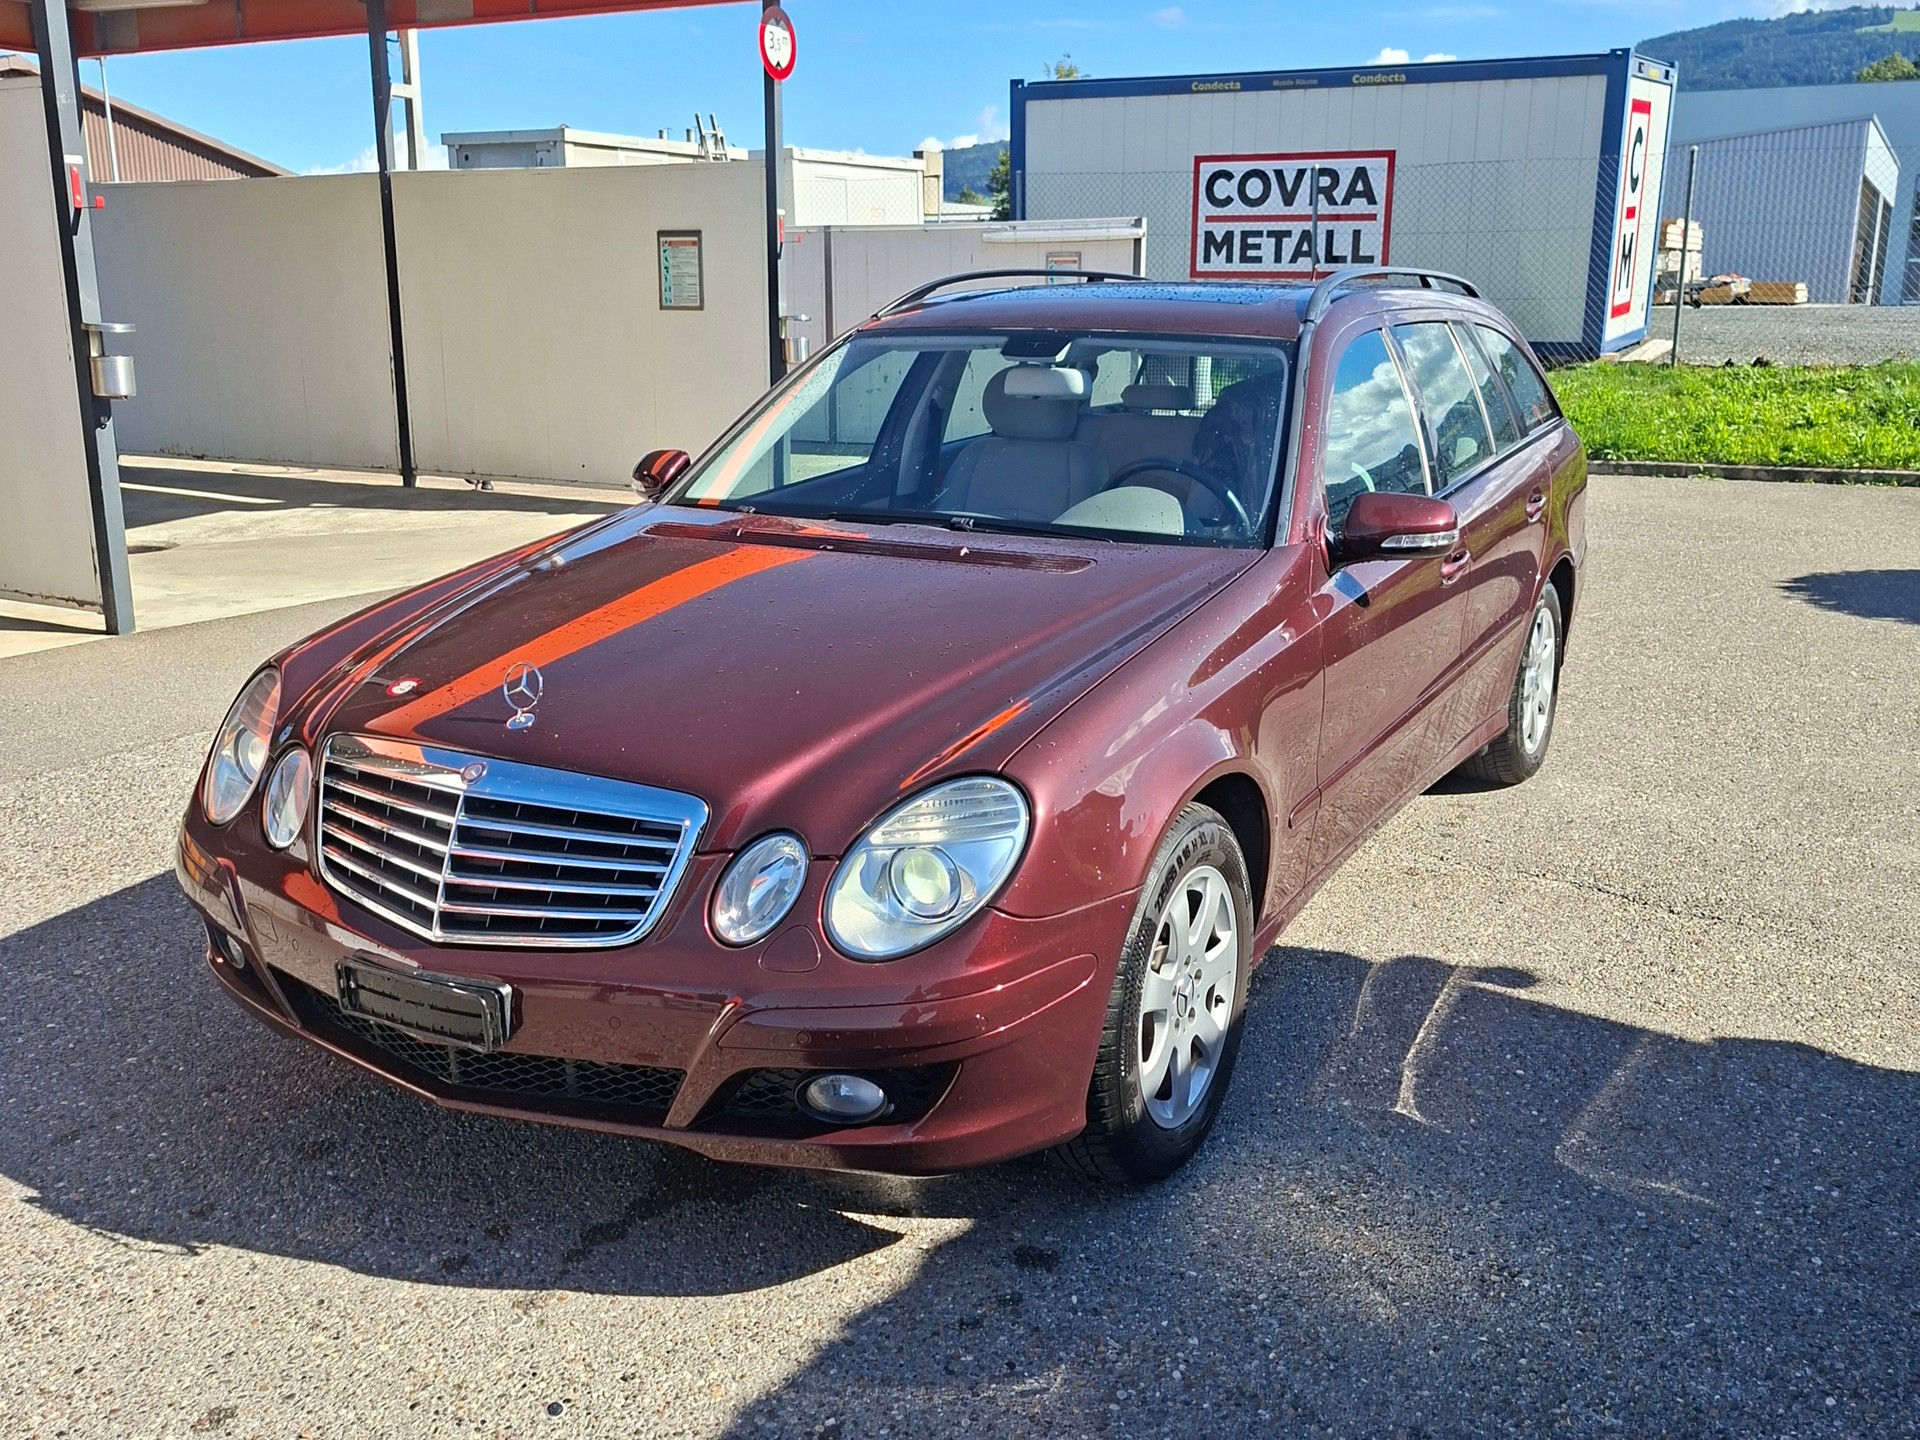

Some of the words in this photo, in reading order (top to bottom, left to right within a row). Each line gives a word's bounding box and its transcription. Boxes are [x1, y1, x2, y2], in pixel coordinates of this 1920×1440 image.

[1191, 81, 1241, 91] Condecta
[1352, 73, 1406, 84] Condecta
[1630, 126, 1643, 194] C
[1205, 166, 1378, 208] COVRA
[1203, 229, 1375, 264] METALL
[1618, 232, 1634, 291] M
